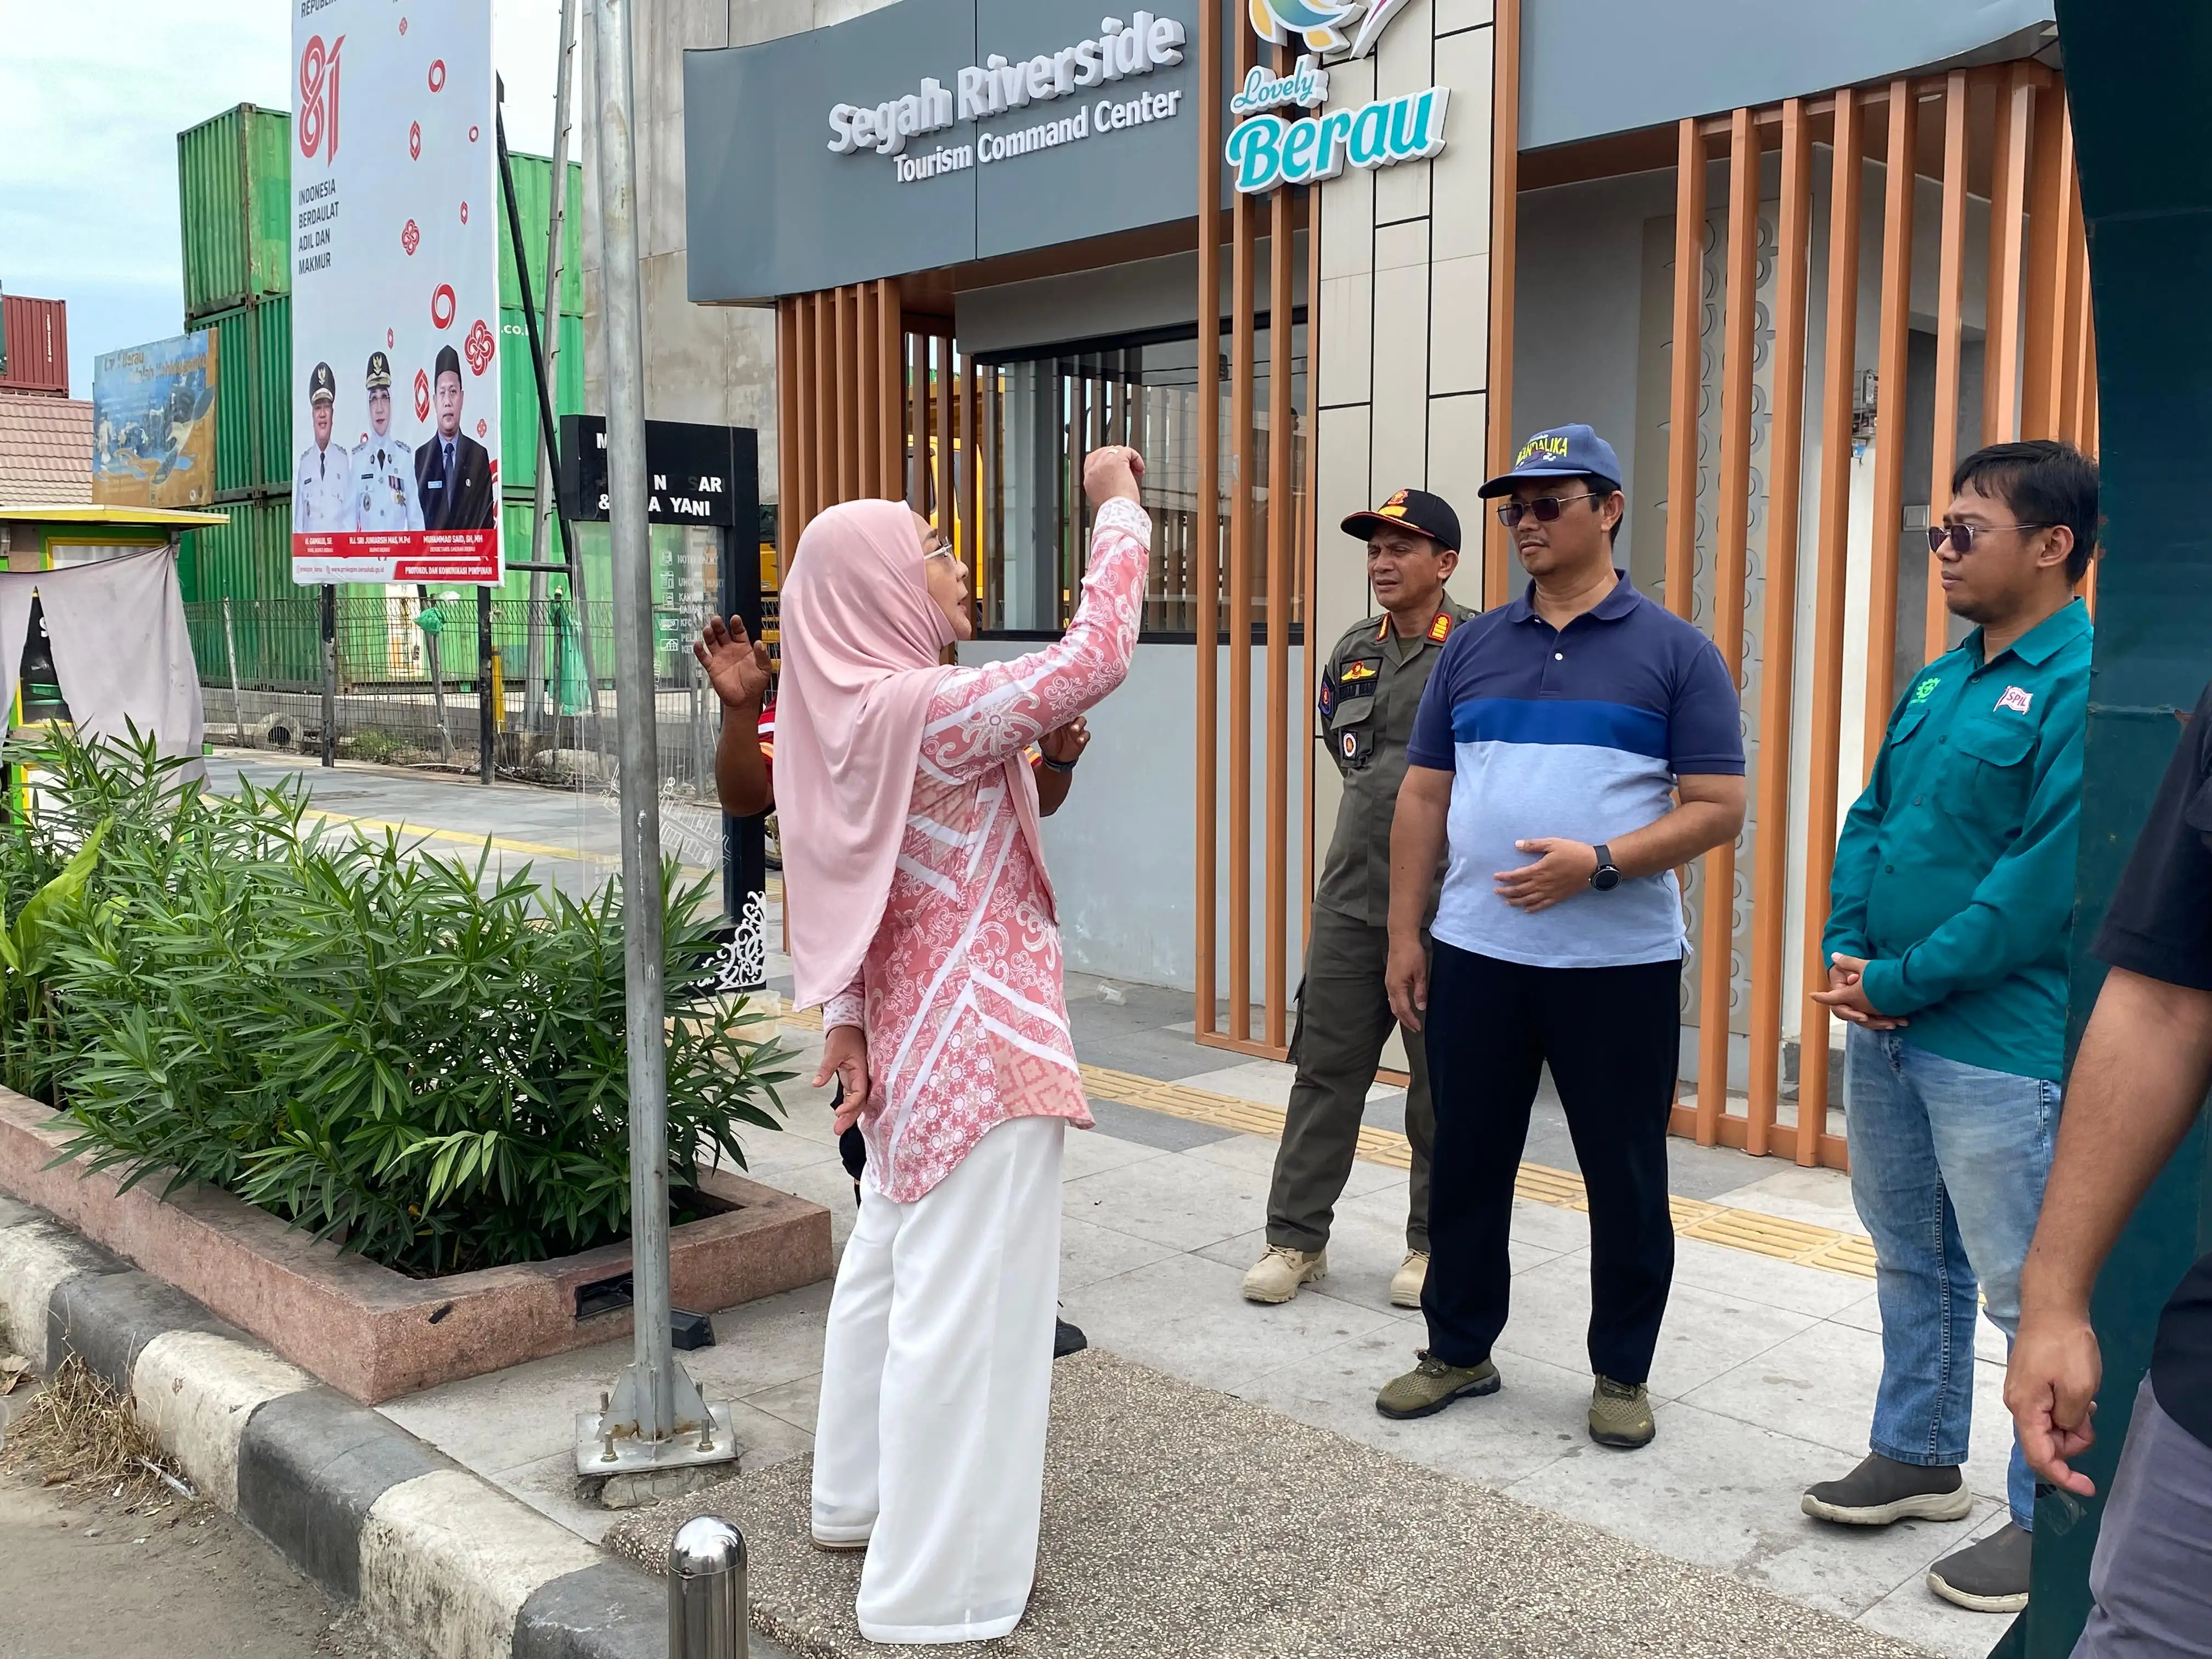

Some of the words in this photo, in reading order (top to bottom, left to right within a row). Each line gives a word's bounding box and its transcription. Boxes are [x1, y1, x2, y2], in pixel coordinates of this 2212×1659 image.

[827, 77, 953, 156] Segah
[957, 10, 1186, 122] Riverside
[1232, 58, 1317, 110] Lovely
[299, 34, 346, 168] 81
[894, 144, 973, 183] Tourism
[977, 105, 1089, 164] Command
[1094, 89, 1182, 133] Center
[1227, 89, 1437, 190] Berau
[298, 178, 336, 206] INDONESIA
[298, 201, 339, 229] BERDAULAT
[298, 233, 314, 252] ADIL
[315, 227, 330, 247] DAN
[298, 252, 331, 275] MAKMUR
[598, 494, 610, 510] &
[669, 497, 710, 516] YANI
[429, 567, 438, 575] DAN
[2006, 691, 2026, 707] SPIL
